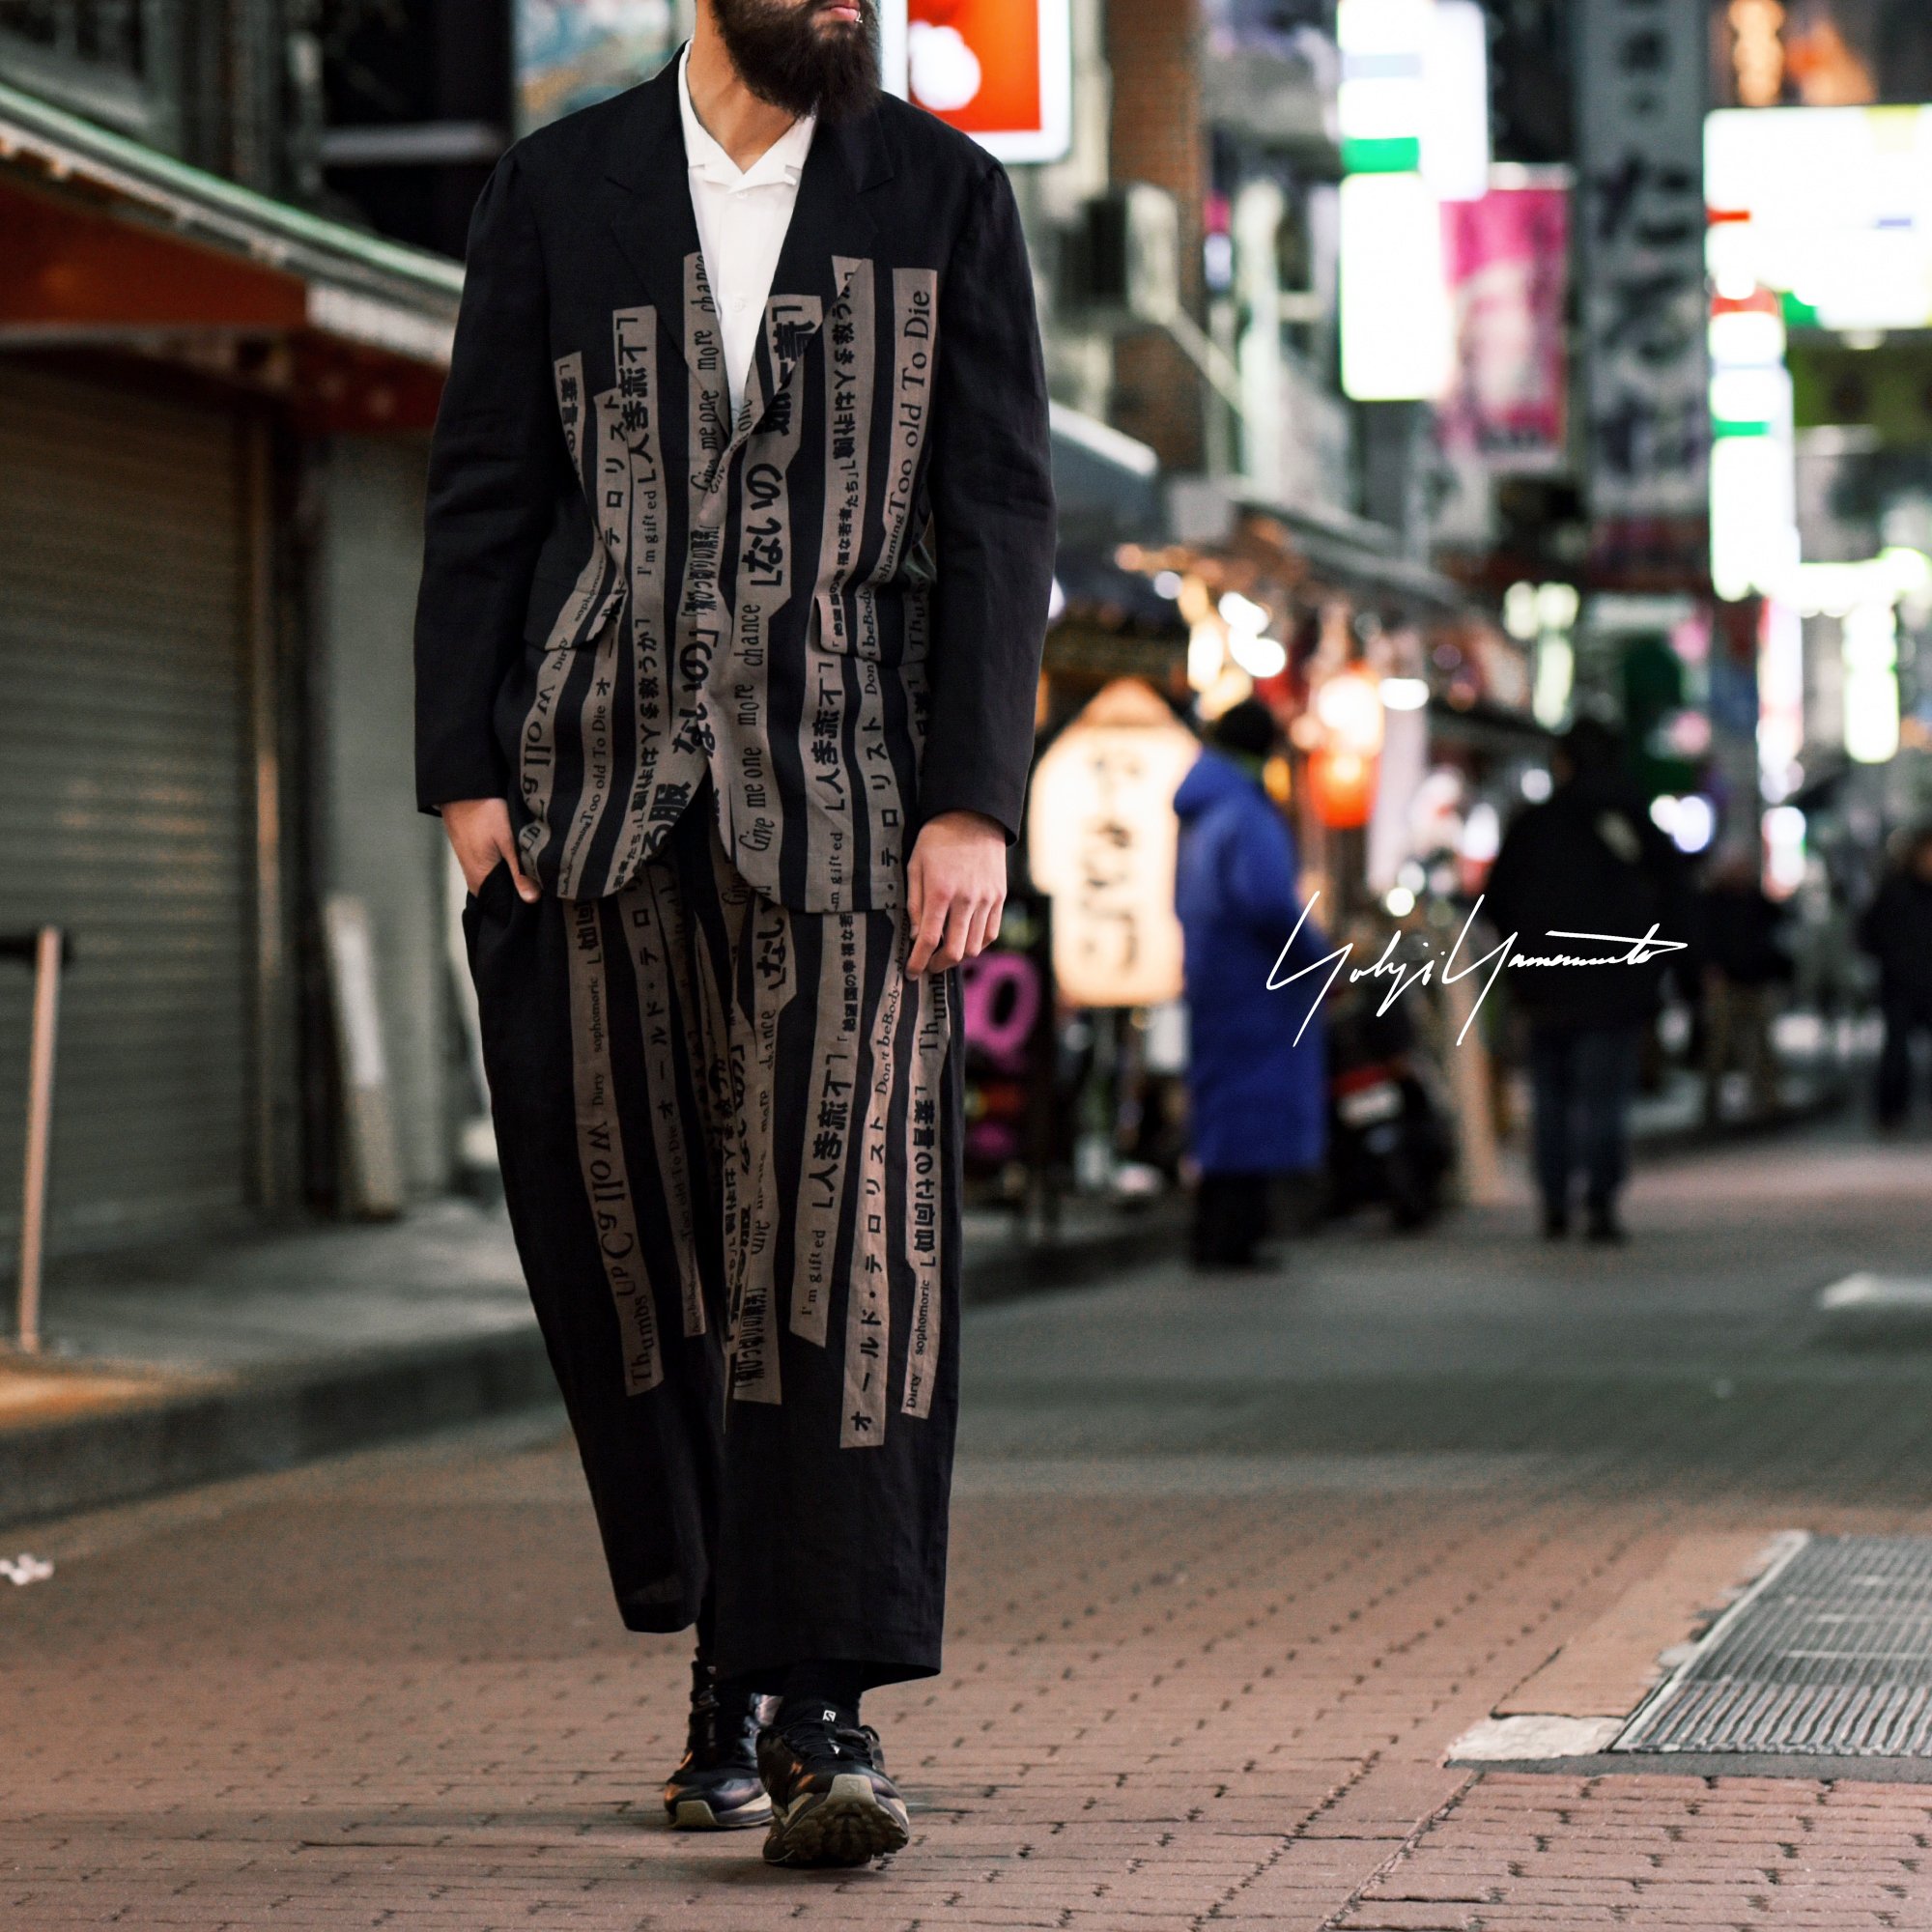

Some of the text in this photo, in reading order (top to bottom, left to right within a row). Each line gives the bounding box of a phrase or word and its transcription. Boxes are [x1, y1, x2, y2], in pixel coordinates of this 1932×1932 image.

[903, 290, 930, 338] Die
[694, 329, 720, 370] more
[901, 352, 928, 391] To
[898, 403, 923, 448] old
[888, 460, 914, 516] Too
[591, 704, 607, 732] Die
[733, 604, 775, 852] Give me one more chance
[591, 737, 607, 758] To
[593, 764, 607, 789] old
[829, 832, 844, 885] gifted
[588, 977, 605, 1053] sophomoric
[591, 1071, 606, 1107] Dirty
[874, 1052, 892, 1096] Don't
[801, 1230, 826, 1316] I'm gifted
[630, 1295, 654, 1387] Thumbs
[905, 1279, 930, 1409] Dirty sophomoric
